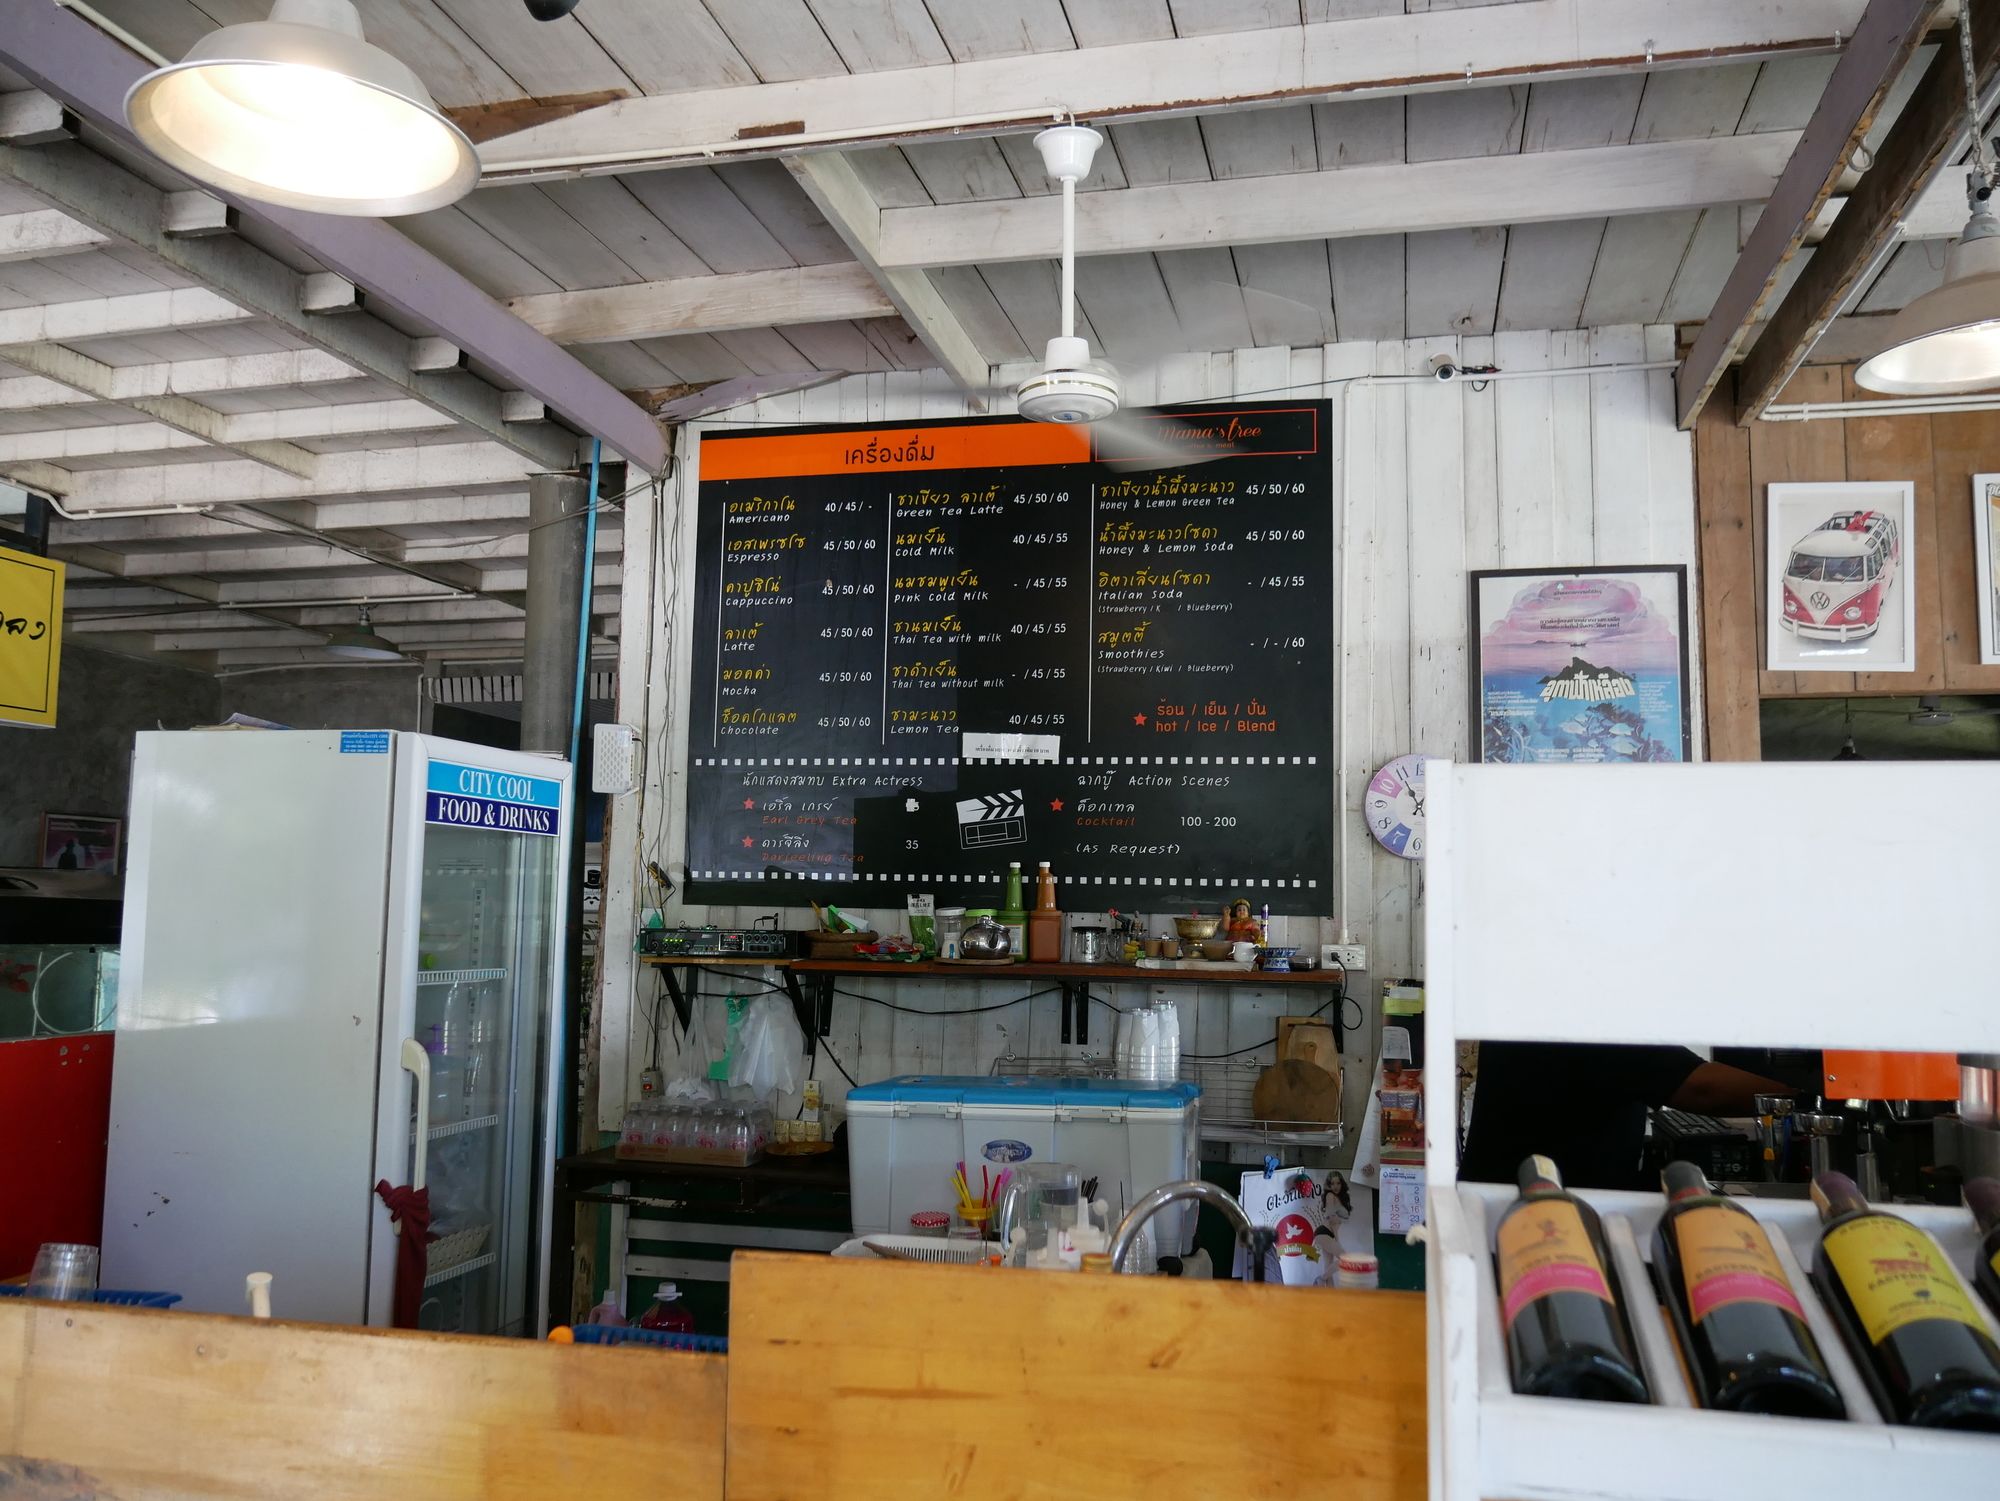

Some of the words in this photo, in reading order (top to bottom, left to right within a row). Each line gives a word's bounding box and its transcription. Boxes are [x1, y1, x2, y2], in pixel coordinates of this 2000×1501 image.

[845, 435, 935, 465] เครื่องดื่ม
[1100, 501, 1127, 510] Honey
[1134, 500, 1140, 508] &
[1147, 499, 1176, 508] Lemon
[1182, 498, 1210, 507] Green
[1217, 497, 1234, 505] Tea
[897, 508, 932, 518] Green
[941, 507, 962, 516] Tea
[970, 506, 1003, 515] Latte
[729, 514, 790, 524] Americano
[896, 547, 921, 557] Cold
[930, 546, 954, 555] Milk
[1099, 545, 1133, 556] Honey
[1143, 545, 1149, 553] &
[1159, 543, 1196, 553] Lemon
[1204, 542, 1233, 551] Soda
[727, 551, 780, 563] Espresso
[929, 592, 954, 601] Cold
[964, 592, 988, 600] Milk
[1099, 591, 1142, 600] Italian
[1152, 589, 1183, 599] Soda
[726, 596, 793, 607] Cappuccino
[893, 634, 916, 644] Thai
[924, 635, 942, 643] Tea
[949, 634, 972, 643] with
[979, 634, 1001, 642] milk
[724, 642, 755, 651] Latte
[1098, 650, 1164, 659] Smoothies
[892, 680, 912, 688] Thai
[919, 680, 935, 688] Tea
[942, 680, 978, 688] without
[984, 679, 1004, 687] milk
[722, 686, 756, 695] Mocha
[1204, 701, 1227, 715] เย็น
[721, 726, 778, 735] Chocolate
[891, 725, 928, 734] Lemon
[936, 725, 959, 733] Tea
[1156, 720, 1178, 732] hot
[1198, 720, 1217, 731] Ice
[1238, 720, 1276, 731] Blend
[459, 770, 494, 796] CITY
[497, 776, 534, 801] COOL
[832, 776, 866, 786] Extra
[875, 776, 923, 786] Actress
[1129, 775, 1172, 786] Action
[1181, 775, 1230, 786] Scenes
[1380, 778, 1395, 794] 10
[438, 797, 481, 824] FOOD
[484, 805, 496, 826] &
[500, 806, 550, 832] DRINKS
[762, 816, 787, 824] Earl
[797, 816, 825, 826] Grey
[834, 816, 858, 825] Tea
[1076, 816, 1136, 826] Cocktail
[1378, 817, 1391, 829] 8
[1392, 830, 1406, 845] 7
[906, 840, 918, 850] 35
[762, 853, 832, 864] Darjeeling
[840, 854, 864, 862] Tea
